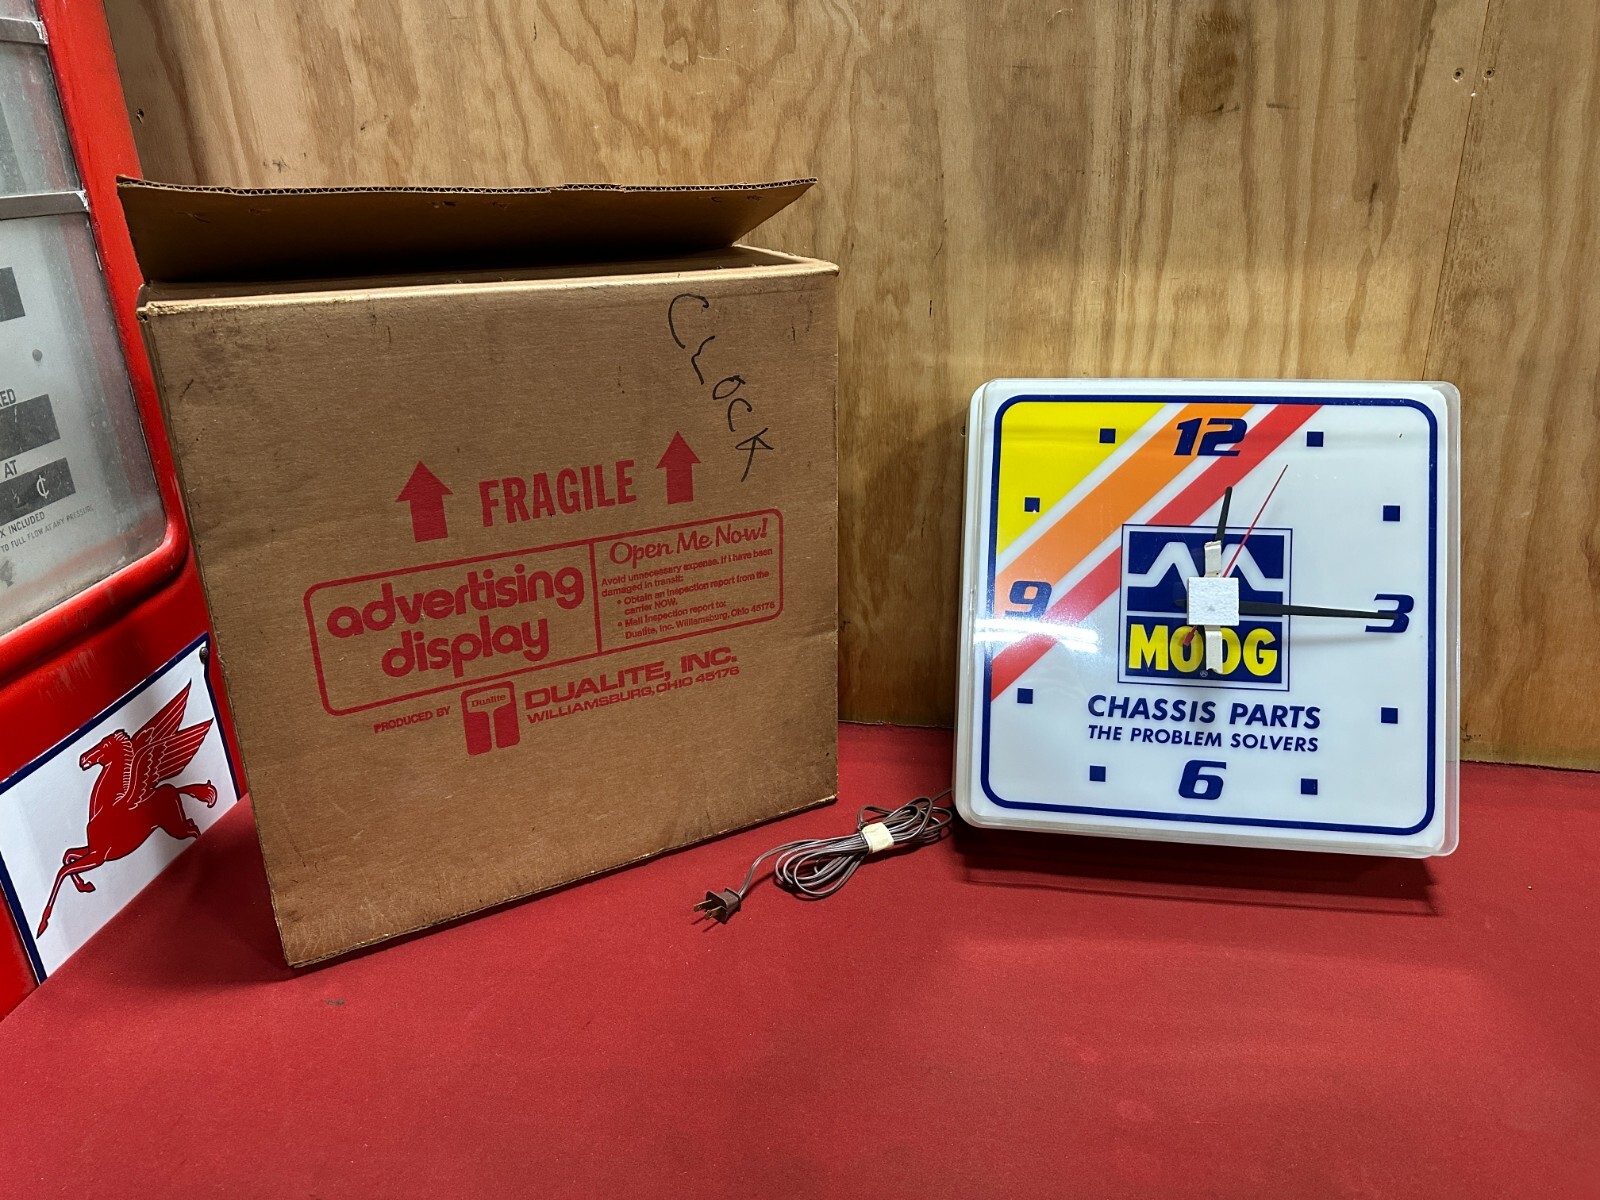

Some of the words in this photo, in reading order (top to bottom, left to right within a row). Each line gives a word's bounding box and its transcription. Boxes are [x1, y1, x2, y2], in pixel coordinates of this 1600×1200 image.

[0, 389, 16, 407] ED
[1173, 417, 1248, 457] 12
[4, 459, 18, 478] AT
[479, 460, 636, 527] FRAGILE
[1, 543, 10, 552] TO
[10, 536, 26, 549] FULL
[27, 528, 43, 540] FLOW
[45, 524, 52, 533] AT
[53, 518, 65, 529] ANY
[8, 511, 45, 535] INCLUDED
[609, 542, 673, 569] Open
[676, 531, 713, 554] Me
[716, 518, 768, 547] Now!
[601, 575, 626, 587] Avoid
[628, 565, 682, 581] unnecessary
[683, 558, 719, 571] expense.
[721, 554, 727, 564] If
[733, 552, 752, 561] have
[753, 548, 773, 557] been
[327, 563, 585, 638] advertising
[601, 583, 642, 597] damaged
[645, 581, 653, 589] in
[654, 574, 684, 586] transit:
[624, 593, 652, 604] Obtain
[667, 582, 709, 596] inspection
[710, 576, 735, 588] report
[736, 573, 755, 583] from
[756, 571, 770, 579] the
[1004, 580, 1052, 619] 9
[624, 604, 652, 615] carrier
[654, 598, 678, 610] NOW.
[624, 616, 643, 627] Mail
[689, 602, 714, 614] report
[715, 600, 727, 608] to:
[625, 626, 657, 639] Dualite,
[659, 624, 674, 633] Inc.
[675, 612, 730, 628] Williamsburg,
[731, 607, 749, 617] Ohio
[751, 601, 775, 612] 45176
[1365, 593, 1414, 633] 3
[381, 618, 549, 679] display
[1129, 624, 1278, 676] MOOG
[524, 661, 671, 710] DUALITE,
[680, 647, 738, 673] INC.
[656, 676, 693, 694] OHIO
[695, 666, 740, 684] 45176
[471, 693, 507, 708] Dualite
[1088, 694, 1216, 724] CHASSIS
[1229, 703, 1321, 729] PARTS
[373, 710, 433, 734] PRODUCED
[436, 705, 451, 718] BY
[1088, 724, 1122, 741] THE
[1130, 727, 1222, 747] PROBLEM
[1230, 733, 1318, 752] SOLVERS
[1178, 759, 1227, 800] 6
